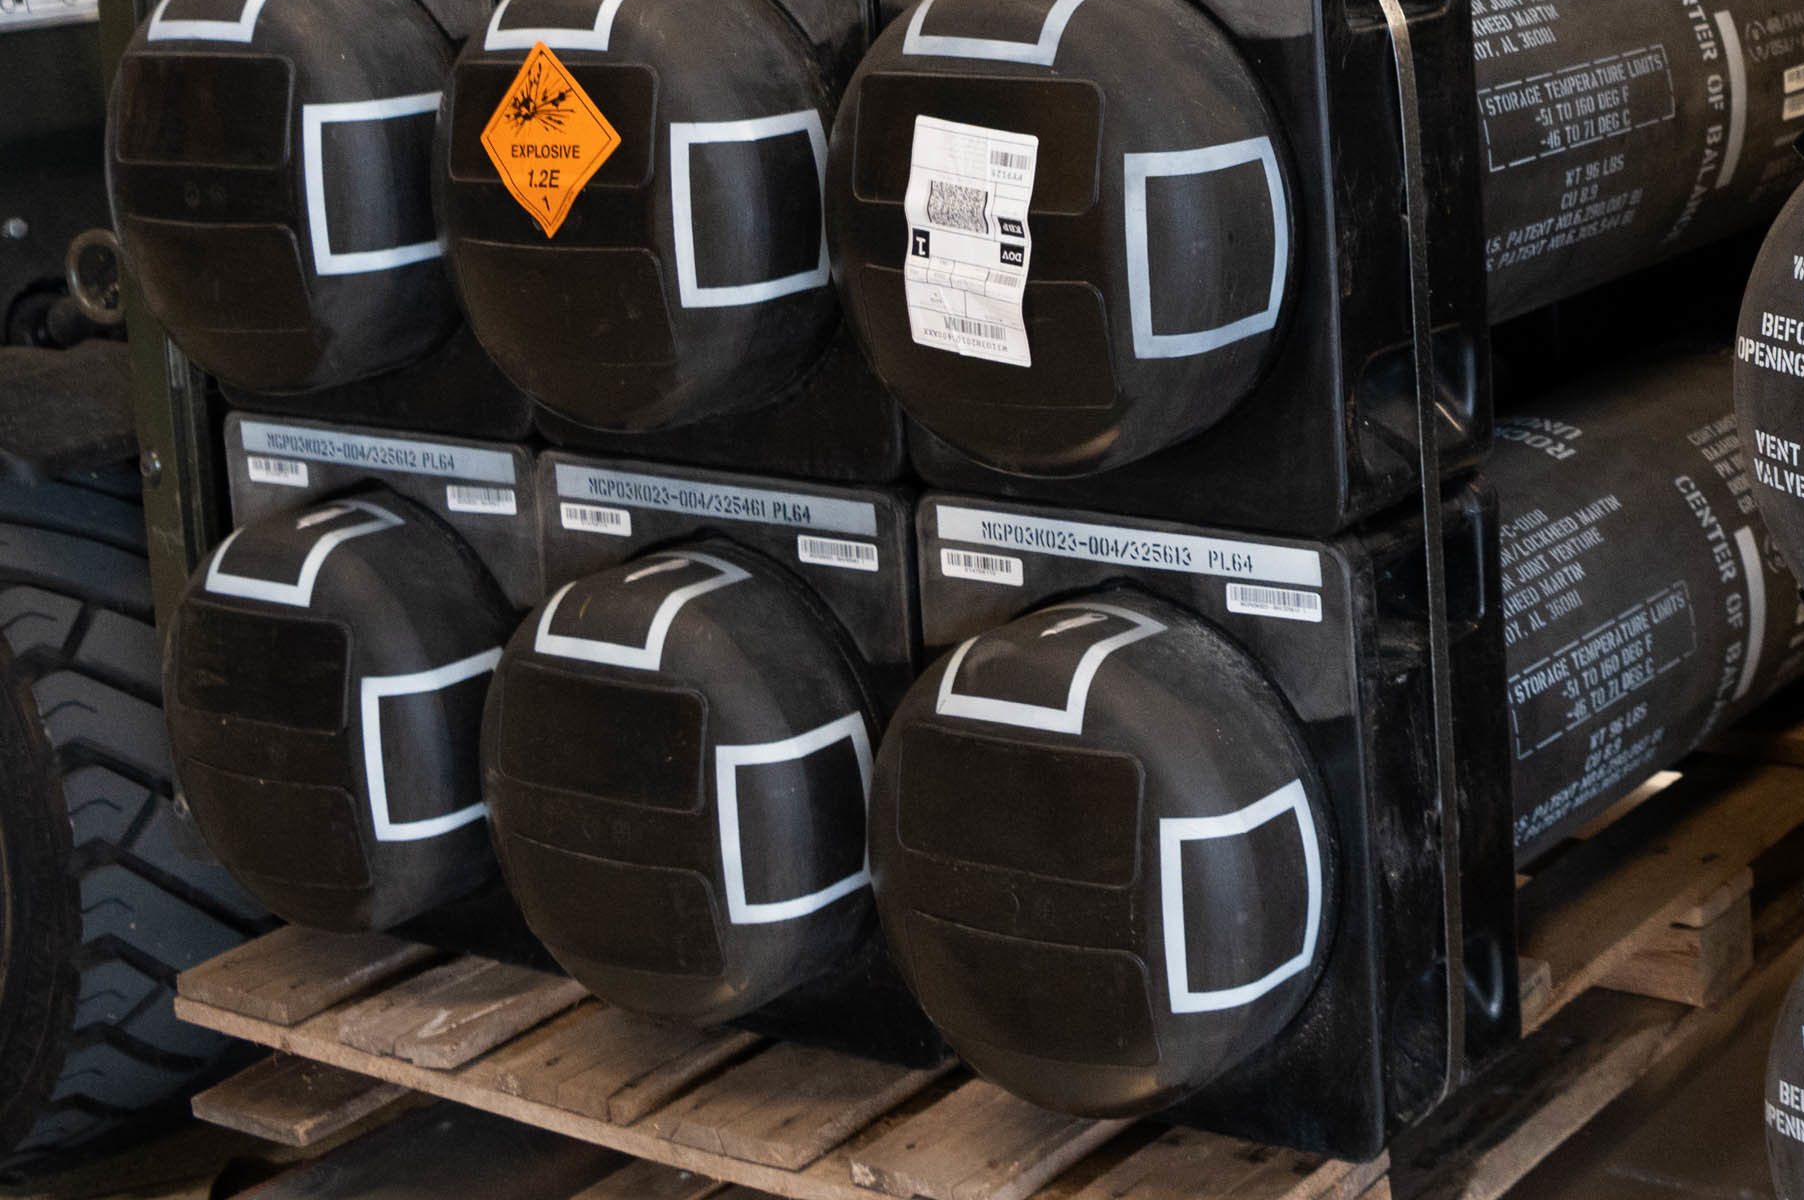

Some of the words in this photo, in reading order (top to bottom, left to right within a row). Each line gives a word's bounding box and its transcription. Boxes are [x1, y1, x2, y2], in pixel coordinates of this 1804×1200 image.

[1515, 2, 1560, 27] MARTIN
[1486, 81, 1542, 117] STORAGE
[1544, 62, 1628, 100] TEMPERATURE
[1627, 54, 1664, 79] LIMITS
[1707, 74, 1725, 112] OF
[1556, 103, 1573, 119] TO
[1598, 91, 1619, 110] DEG
[1621, 85, 1630, 103] F
[1564, 125, 1581, 144] TO
[1598, 115, 1619, 134] DEG
[1621, 108, 1631, 128] C
[511, 144, 581, 159] EXPLOSIVE
[1602, 154, 1624, 177] LBS
[528, 169, 561, 189] 1.2E
[542, 196, 550, 211] 1
[1560, 189, 1578, 210] CU
[915, 236, 927, 256] 1
[1506, 217, 1554, 249] PATENT
[1001, 250, 1023, 263] DOV
[422, 451, 456, 471] PL64
[1755, 429, 1801, 467] VENT
[772, 502, 812, 524] PL64
[1575, 494, 1624, 525] MARTIN
[981, 520, 1193, 567] MGP03K023-004/325613
[1207, 549, 1254, 574] PL64
[1517, 553, 1552, 584] JOINT
[1551, 527, 1605, 567] VENTURE
[1674, 473, 1737, 584] CENTER
[1724, 591, 1744, 629] OF
[1539, 561, 1586, 598] MARTIN
[1529, 610, 1547, 634] AL
[1513, 665, 1569, 705] STORAGE
[1571, 611, 1651, 671] TEMPERATURE
[1650, 594, 1686, 626] LIMITS
[1583, 670, 1599, 689] TO
[1620, 644, 1644, 672] DEG
[1644, 634, 1653, 652] F
[1589, 688, 1606, 710] TO
[1620, 665, 1644, 692] DEG
